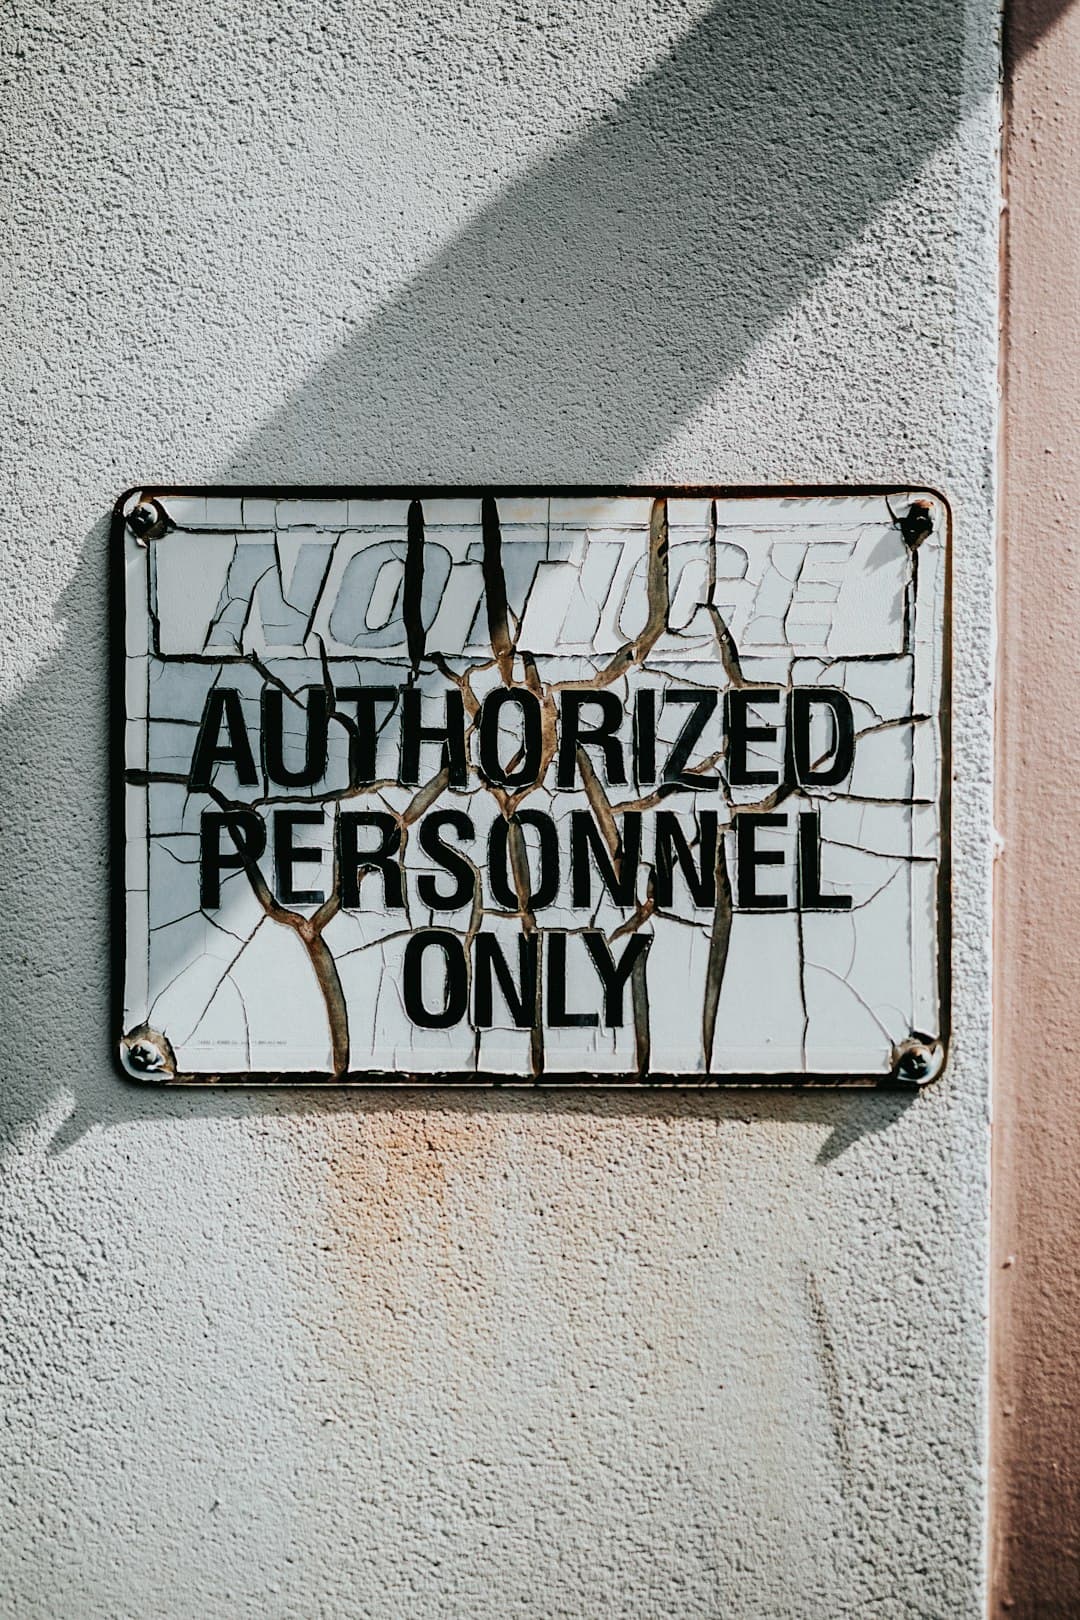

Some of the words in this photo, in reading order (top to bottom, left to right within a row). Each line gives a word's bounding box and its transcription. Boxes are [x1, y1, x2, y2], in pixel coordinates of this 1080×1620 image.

[203, 540, 857, 648] NOTICE
[191, 688, 854, 788] AUTHORIZED
[199, 809, 853, 909] PERSONNEL
[403, 931, 653, 1029] ONLY
